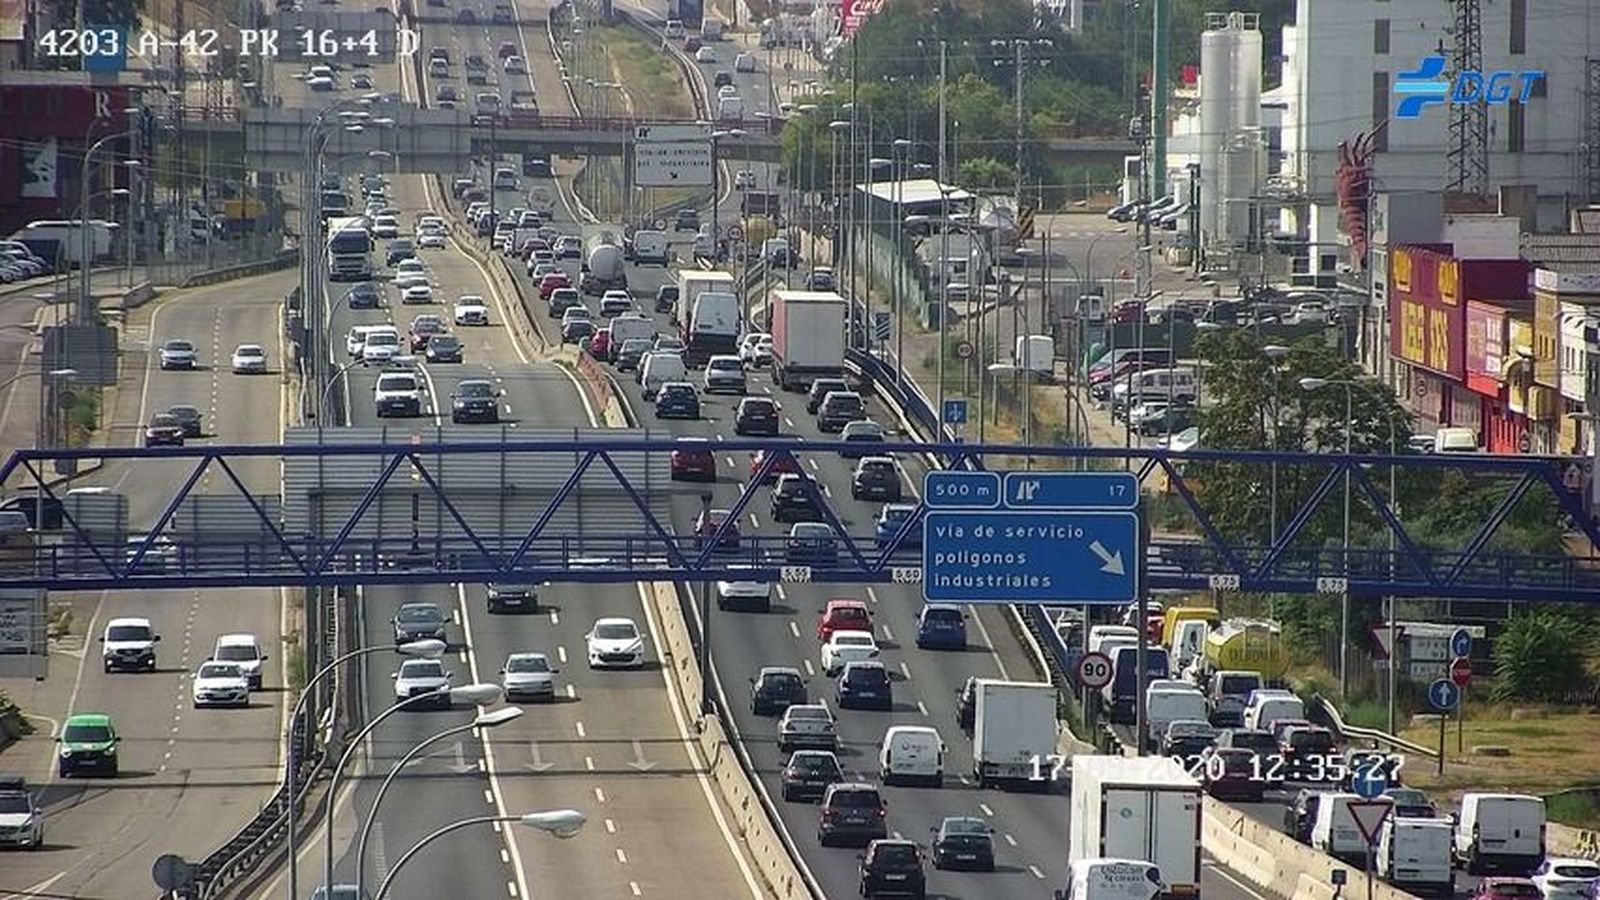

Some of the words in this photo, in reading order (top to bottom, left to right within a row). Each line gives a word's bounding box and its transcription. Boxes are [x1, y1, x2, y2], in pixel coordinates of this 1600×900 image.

[936, 484, 969, 496] 500
[977, 486, 989, 495] m
[1109, 485, 1126, 497] 17
[974, 525, 994, 538] de
[1005, 525, 1084, 539] servicio
[935, 573, 1051, 587] industriales
[1084, 663, 1106, 677] 90
